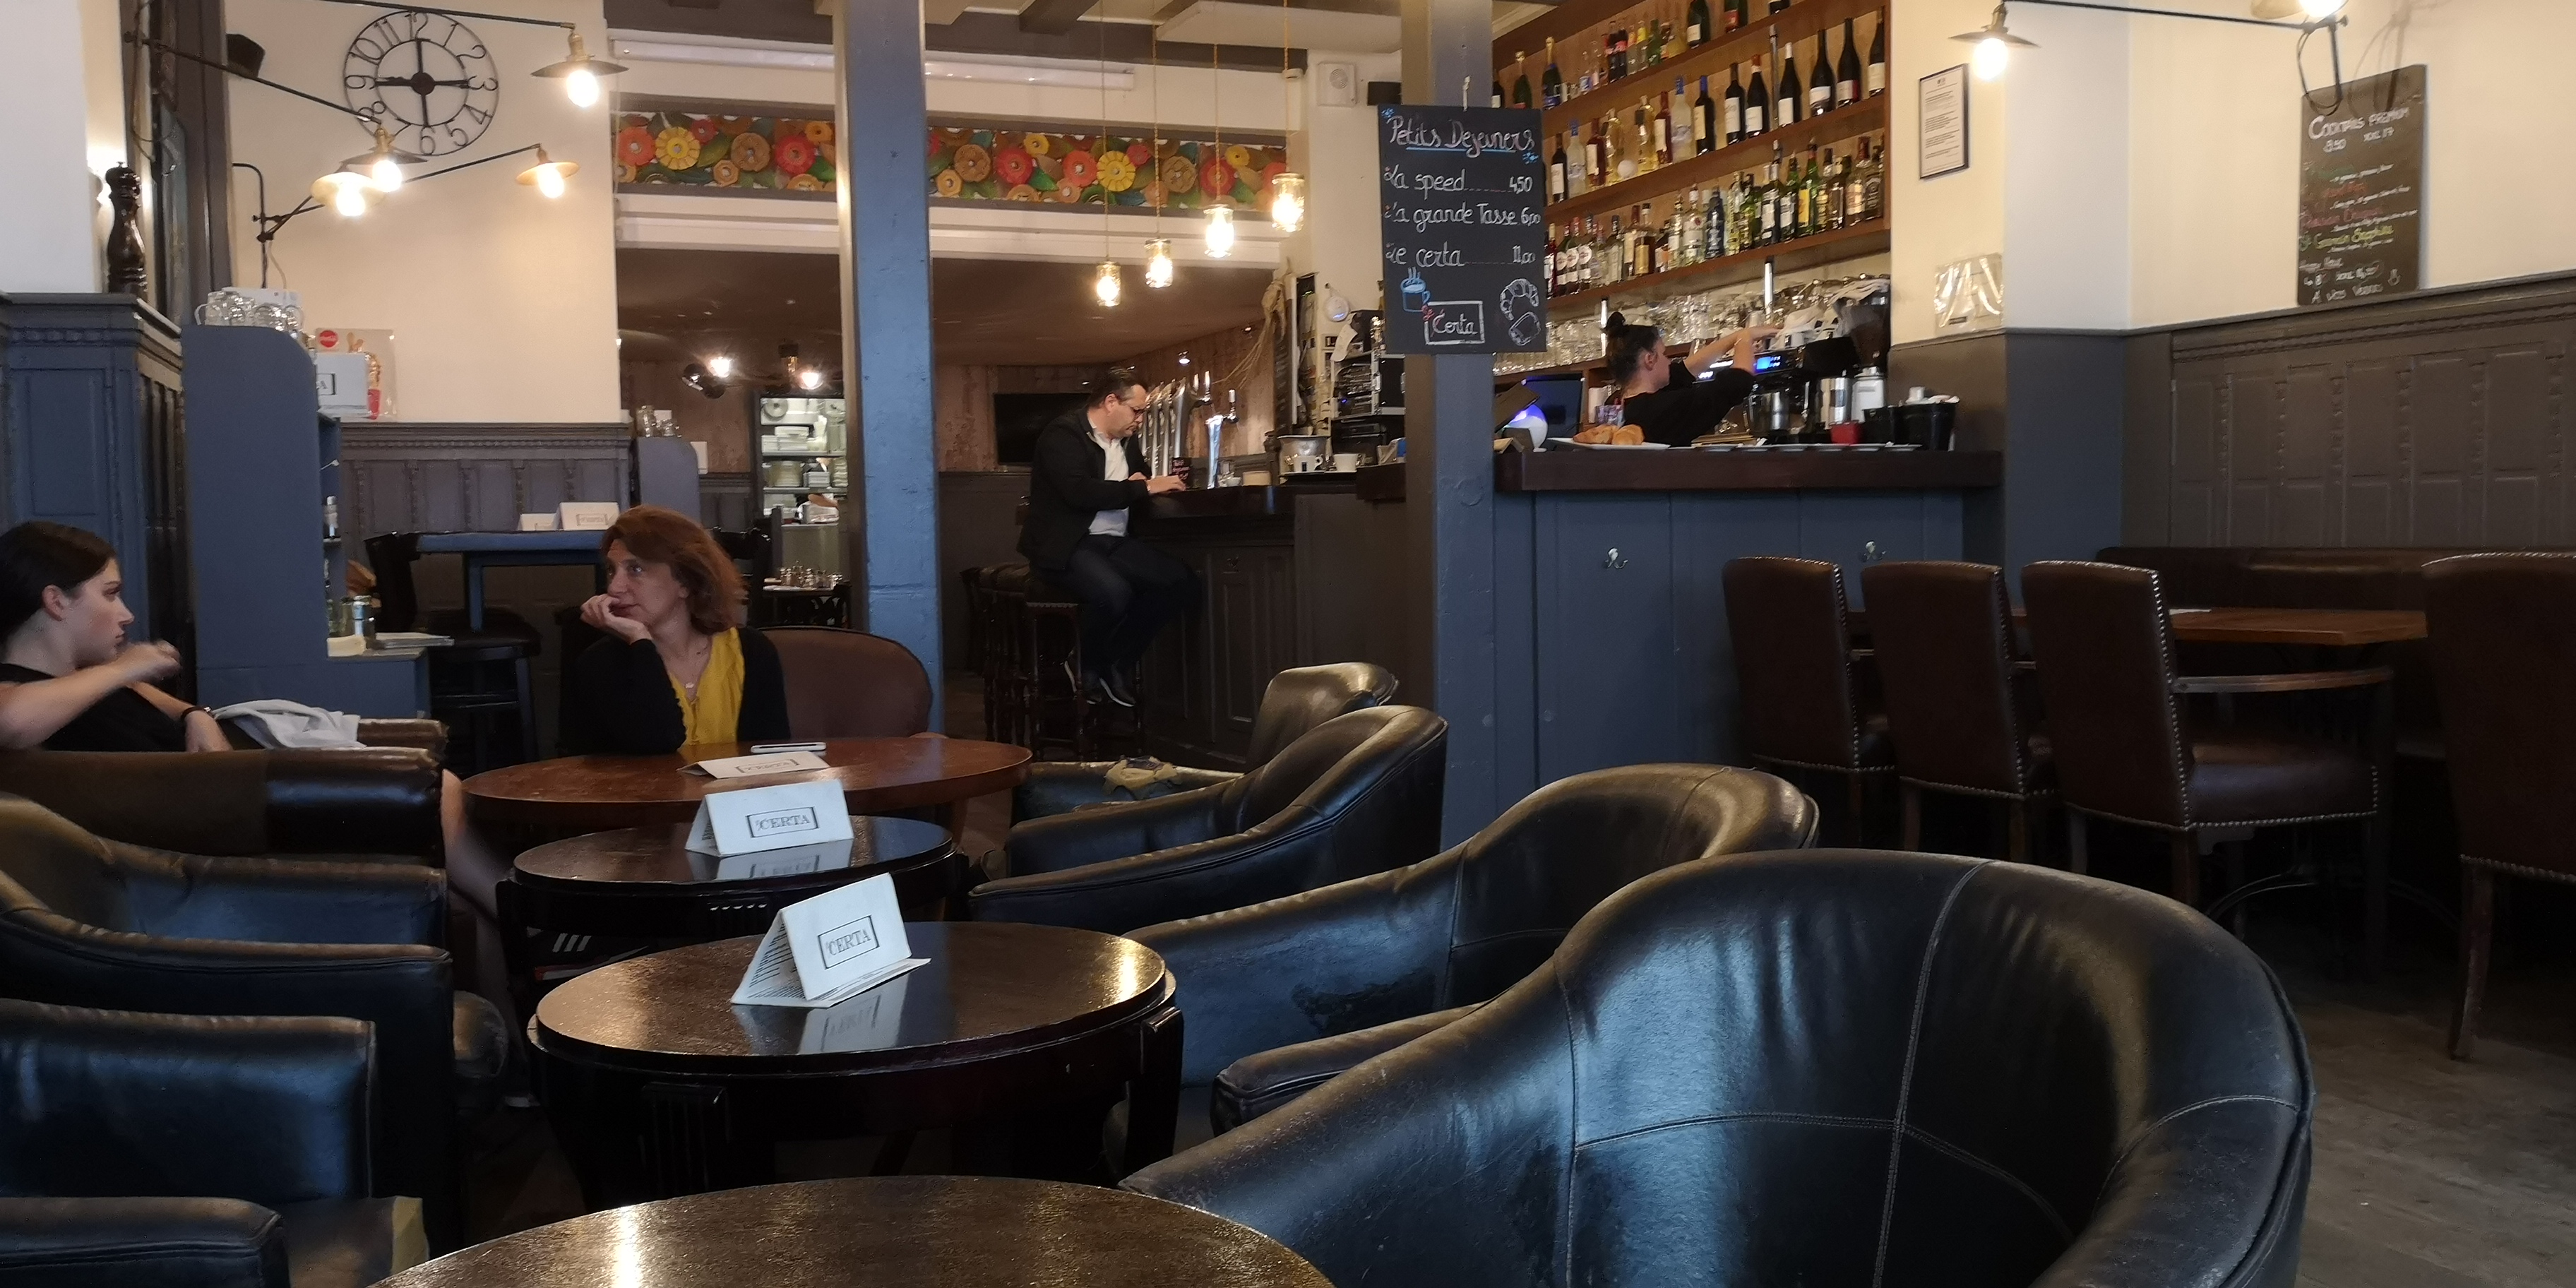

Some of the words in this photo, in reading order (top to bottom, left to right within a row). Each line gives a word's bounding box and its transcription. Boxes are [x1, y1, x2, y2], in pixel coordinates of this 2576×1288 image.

[374, 18, 402, 47] 11
[443, 23, 458, 47] 1
[348, 38, 386, 65] 10
[456, 44, 486, 69] 2
[345, 75, 376, 90] 9
[468, 75, 498, 91] 3
[463, 104, 493, 124] 4
[420, 126, 436, 155] 6
[444, 119, 469, 146] 5
[1386, 115, 1441, 148] Petits
[1444, 119, 1535, 158] Dejeuners
[1383, 164, 1409, 189] La
[1414, 168, 1466, 200] speed
[1413, 201, 1474, 233] grande
[1477, 203, 1517, 225] Tasse
[1432, 312, 1479, 335] Certa
[759, 814, 811, 830] CERTA
[828, 929, 871, 956] CERTA
